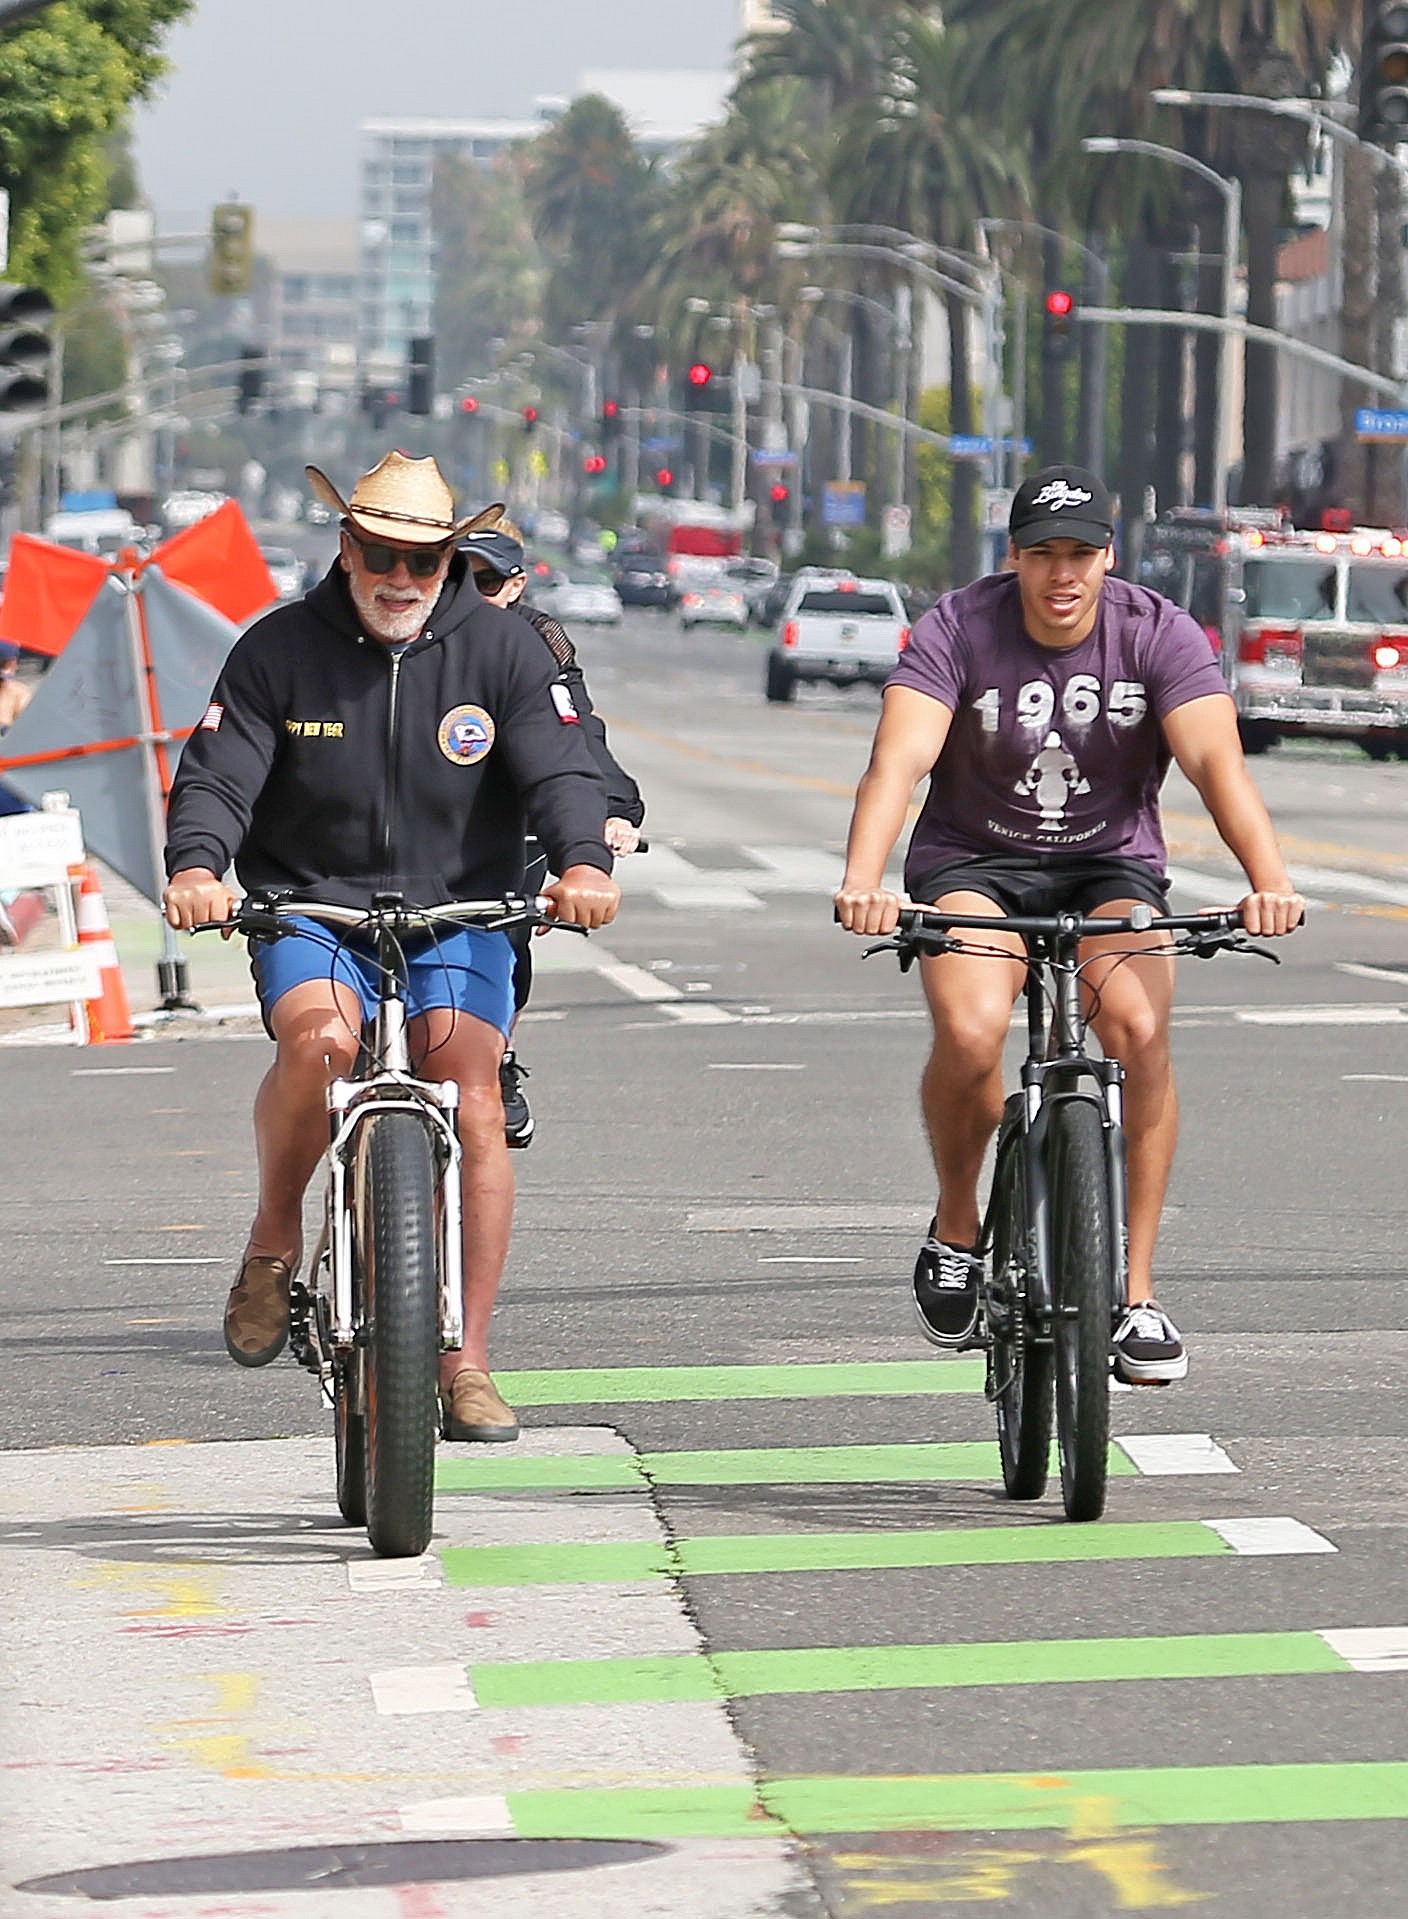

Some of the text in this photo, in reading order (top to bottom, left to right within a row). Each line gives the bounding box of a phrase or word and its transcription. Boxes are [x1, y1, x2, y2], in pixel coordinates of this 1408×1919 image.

[972, 674, 1148, 732] 1965
[303, 722, 321, 737] NEW
[322, 722, 344, 738] YEAR
[987, 819, 1107, 844] VENICE CALIFORNIA
